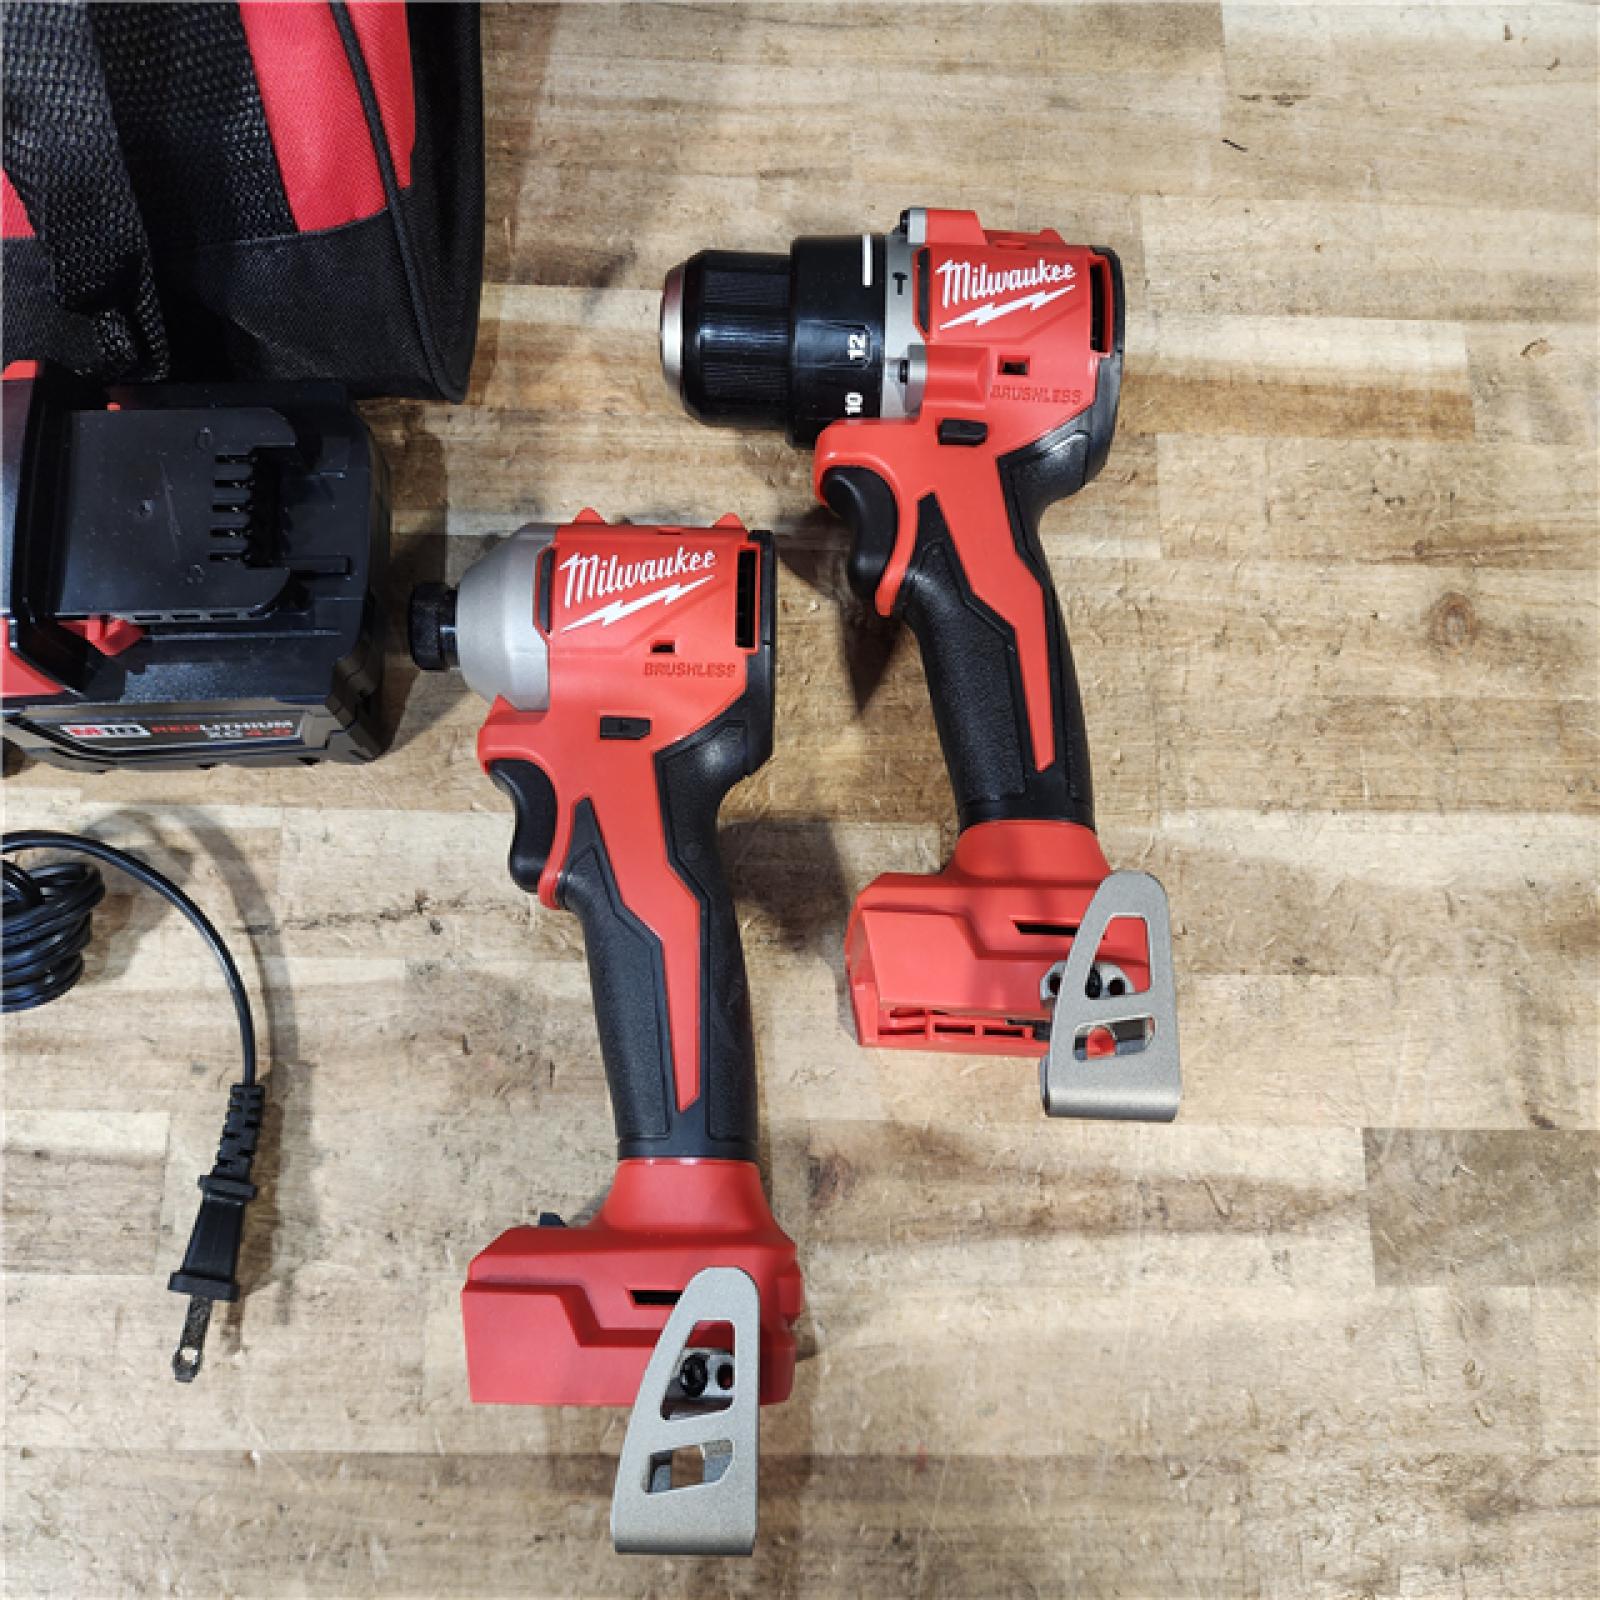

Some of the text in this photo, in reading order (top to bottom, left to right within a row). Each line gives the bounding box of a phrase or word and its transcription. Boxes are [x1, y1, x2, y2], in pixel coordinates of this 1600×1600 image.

[936, 259, 1076, 307] Milwaukee
[848, 334, 866, 361] 12
[845, 392, 863, 415] 10
[990, 384, 1083, 405] BRUSHLESS
[559, 546, 717, 608] Milwaukee
[644, 662, 737, 678] BRUSHLESS
